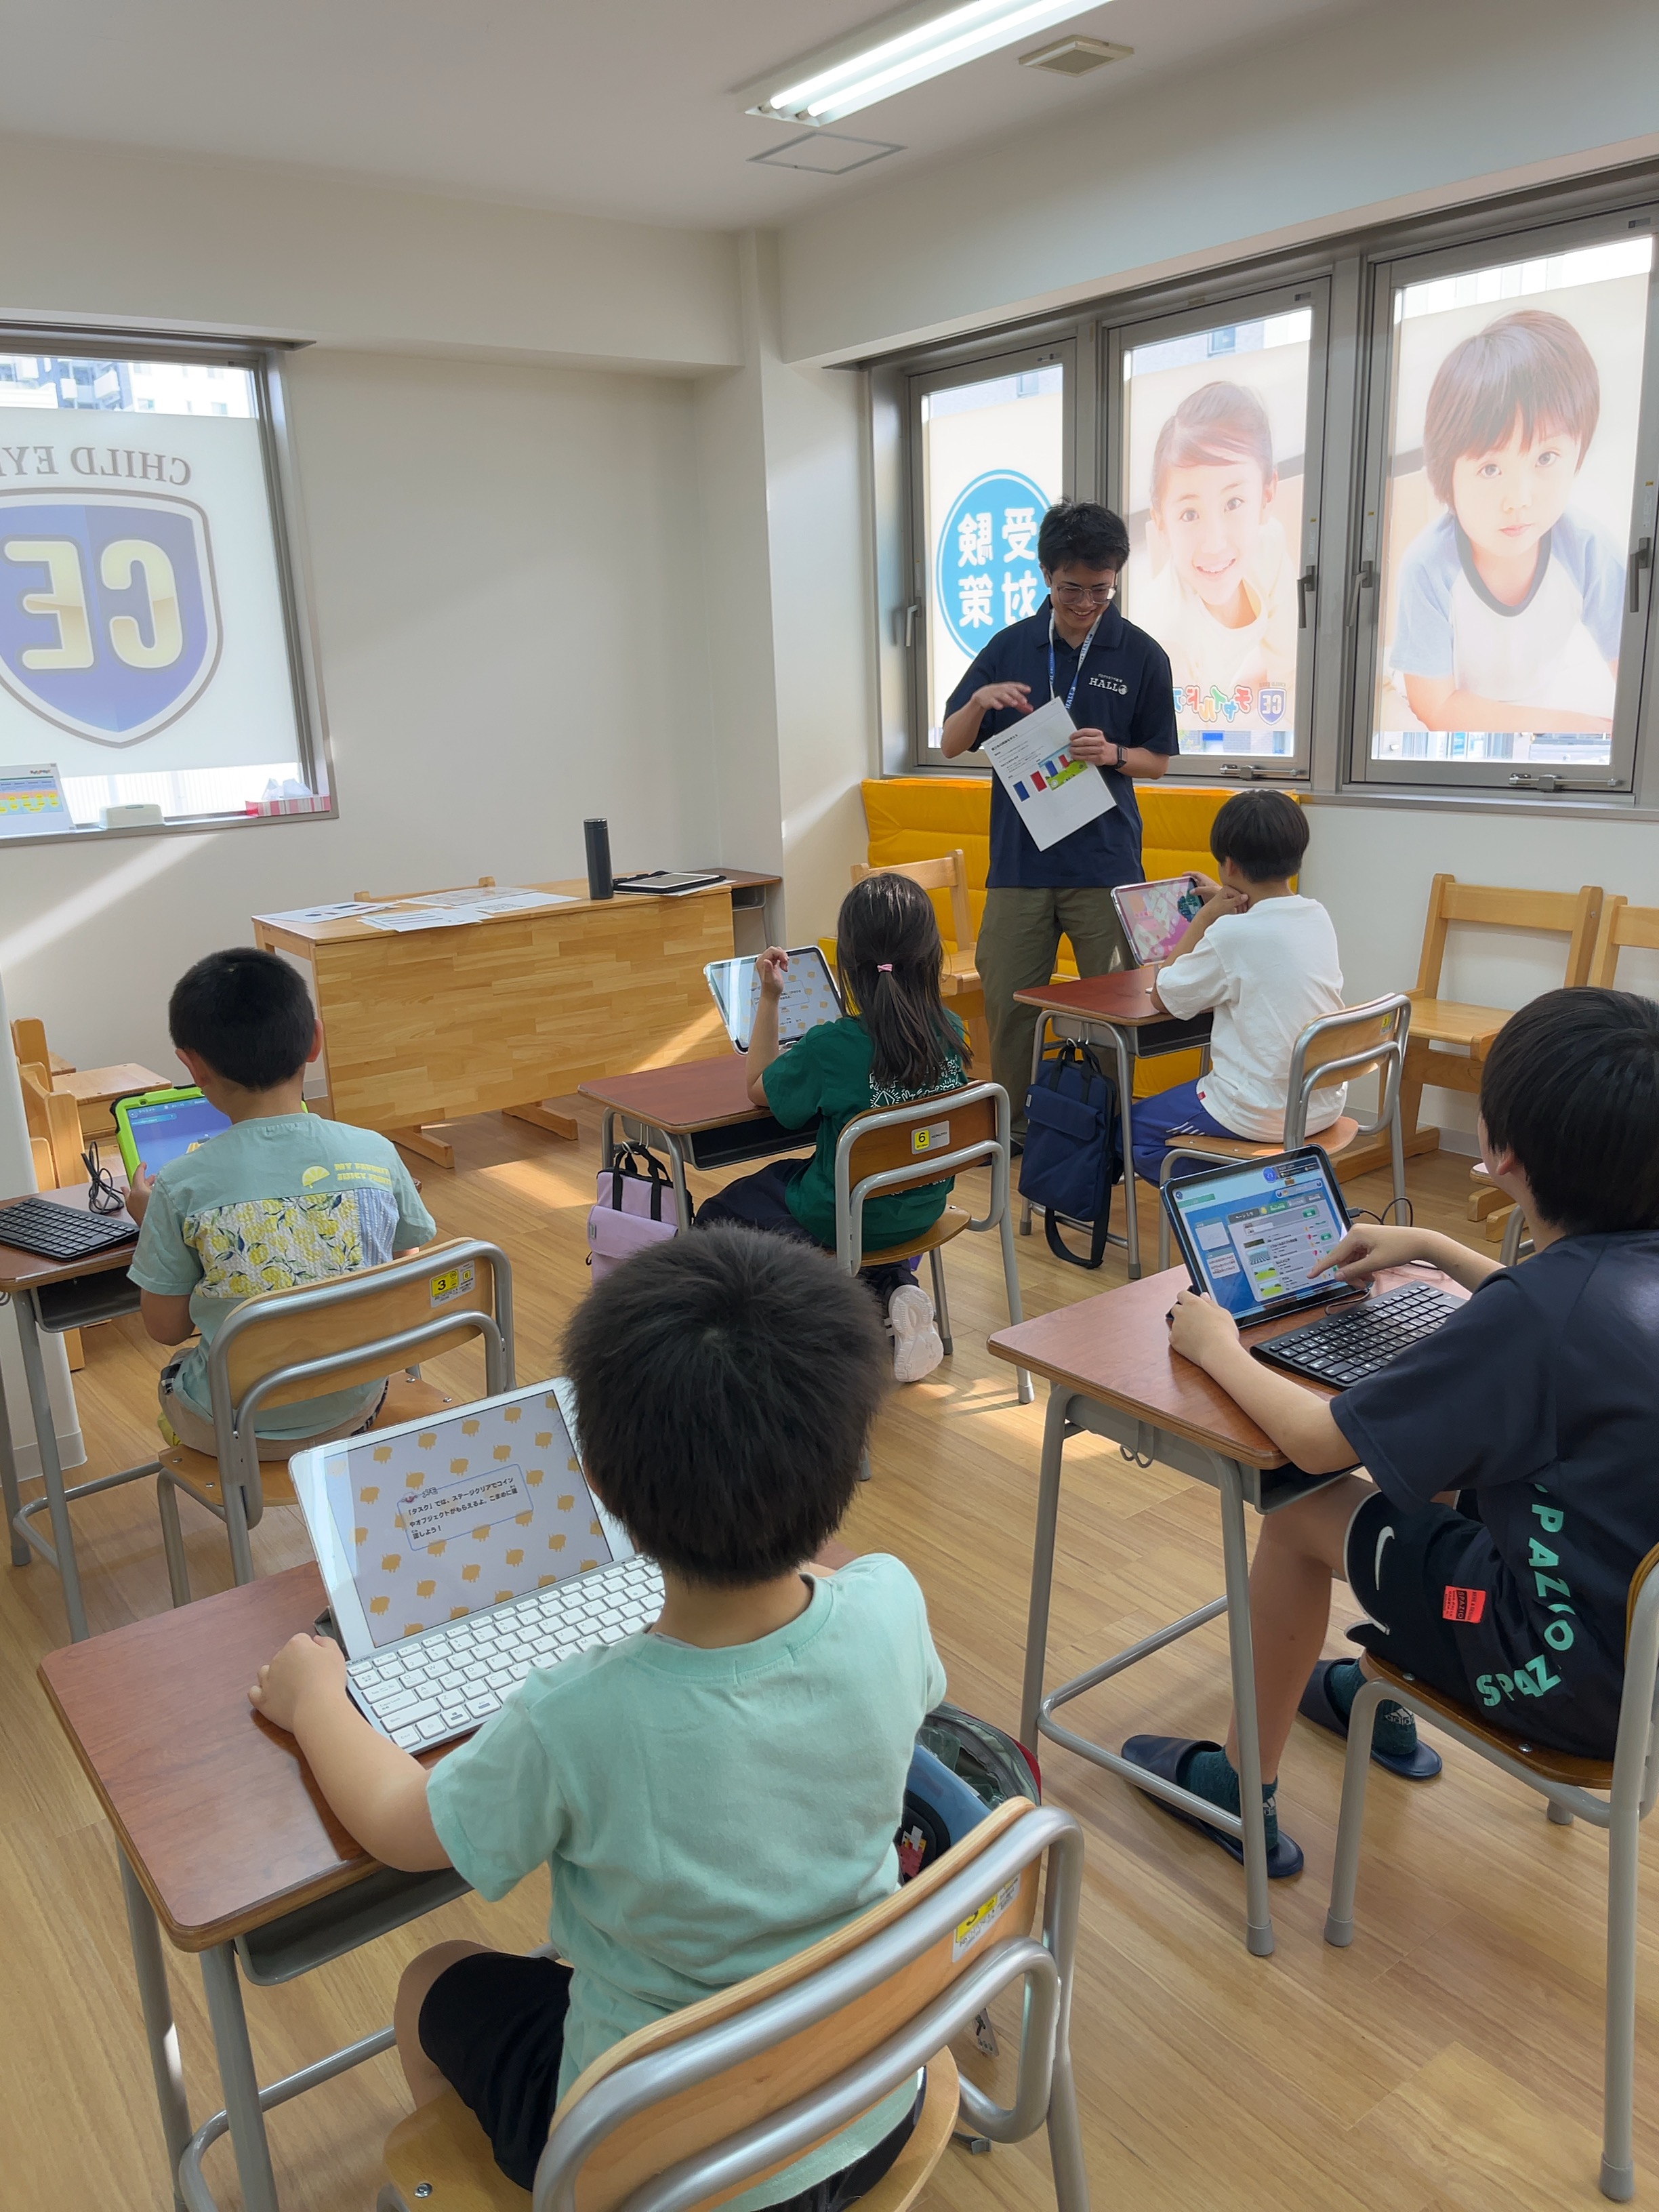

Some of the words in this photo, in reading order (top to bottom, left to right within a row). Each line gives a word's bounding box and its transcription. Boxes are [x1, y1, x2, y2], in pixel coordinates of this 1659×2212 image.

[918, 1132, 926, 1143] 6
[438, 1279, 446, 1290] 3
[1528, 1483, 1576, 1651] PAZIO
